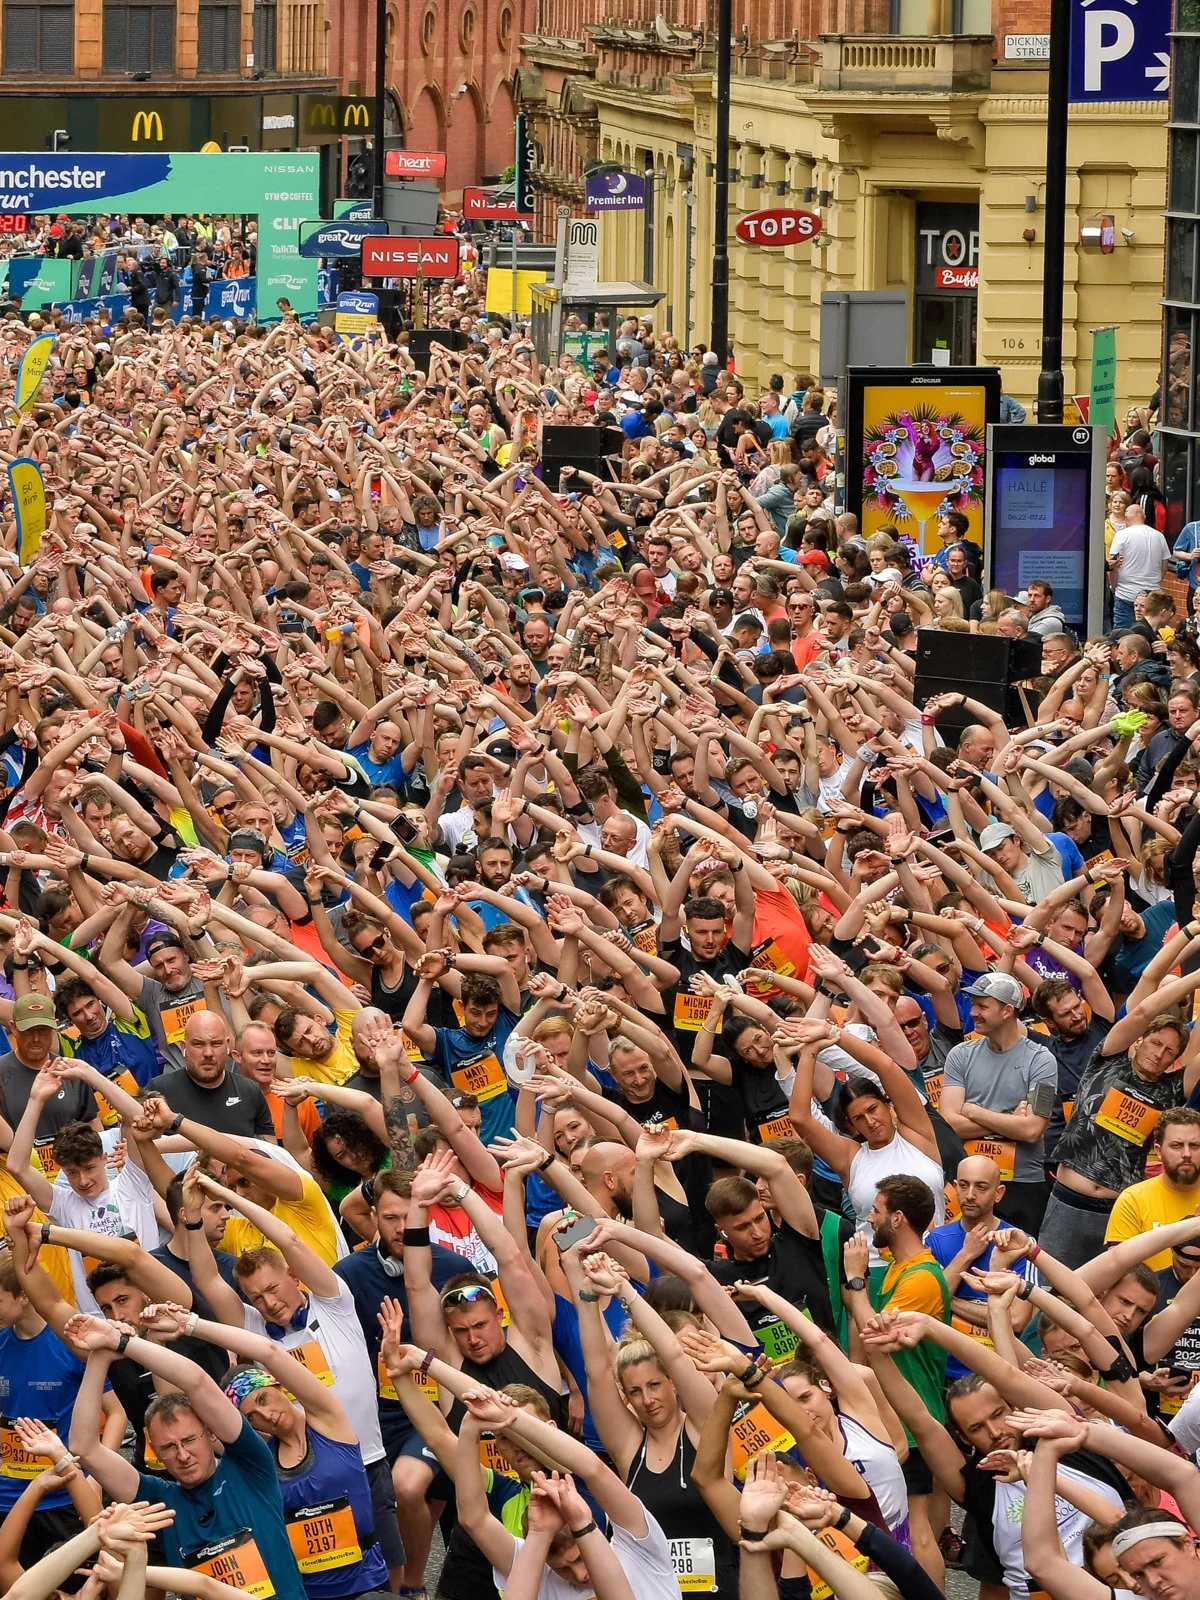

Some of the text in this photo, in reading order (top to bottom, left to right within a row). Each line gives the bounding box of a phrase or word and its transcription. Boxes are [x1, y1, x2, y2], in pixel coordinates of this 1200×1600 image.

[1007, 37, 1050, 46] DICKINS
[1016, 48, 1048, 56] STREE
[1084, 10, 1135, 91] P
[399, 154, 431, 168] heart
[264, 192, 313, 201] GYM COFFEE
[471, 198, 517, 208] NISSA
[588, 195, 643, 205] Premier Inn
[744, 217, 813, 238] TOPS
[318, 232, 341, 243] great
[920, 229, 980, 266] TOP
[371, 251, 449, 263] NISSAN
[1001, 338, 1024, 349] 106
[32, 357, 42, 366] 45
[1028, 454, 1056, 466] global
[22, 481, 33, 495] 50
[683, 997, 712, 1009] MICHAE
[175, 1004, 195, 1018] RYAN
[463, 1065, 485, 1081] MATT
[469, 1074, 490, 1091] 2397
[1119, 1097, 1147, 1118] DAVID
[1114, 1109, 1140, 1129] 1223
[974, 1142, 1002, 1154] JAMES
[740, 1430, 771, 1457] 1586
[308, 1502, 334, 1512] manchester
[303, 1518, 333, 1538] RUTH
[307, 1534, 337, 1555] 2197
[670, 1541, 691, 1557] ATE
[210, 1554, 239, 1578] JOHN
